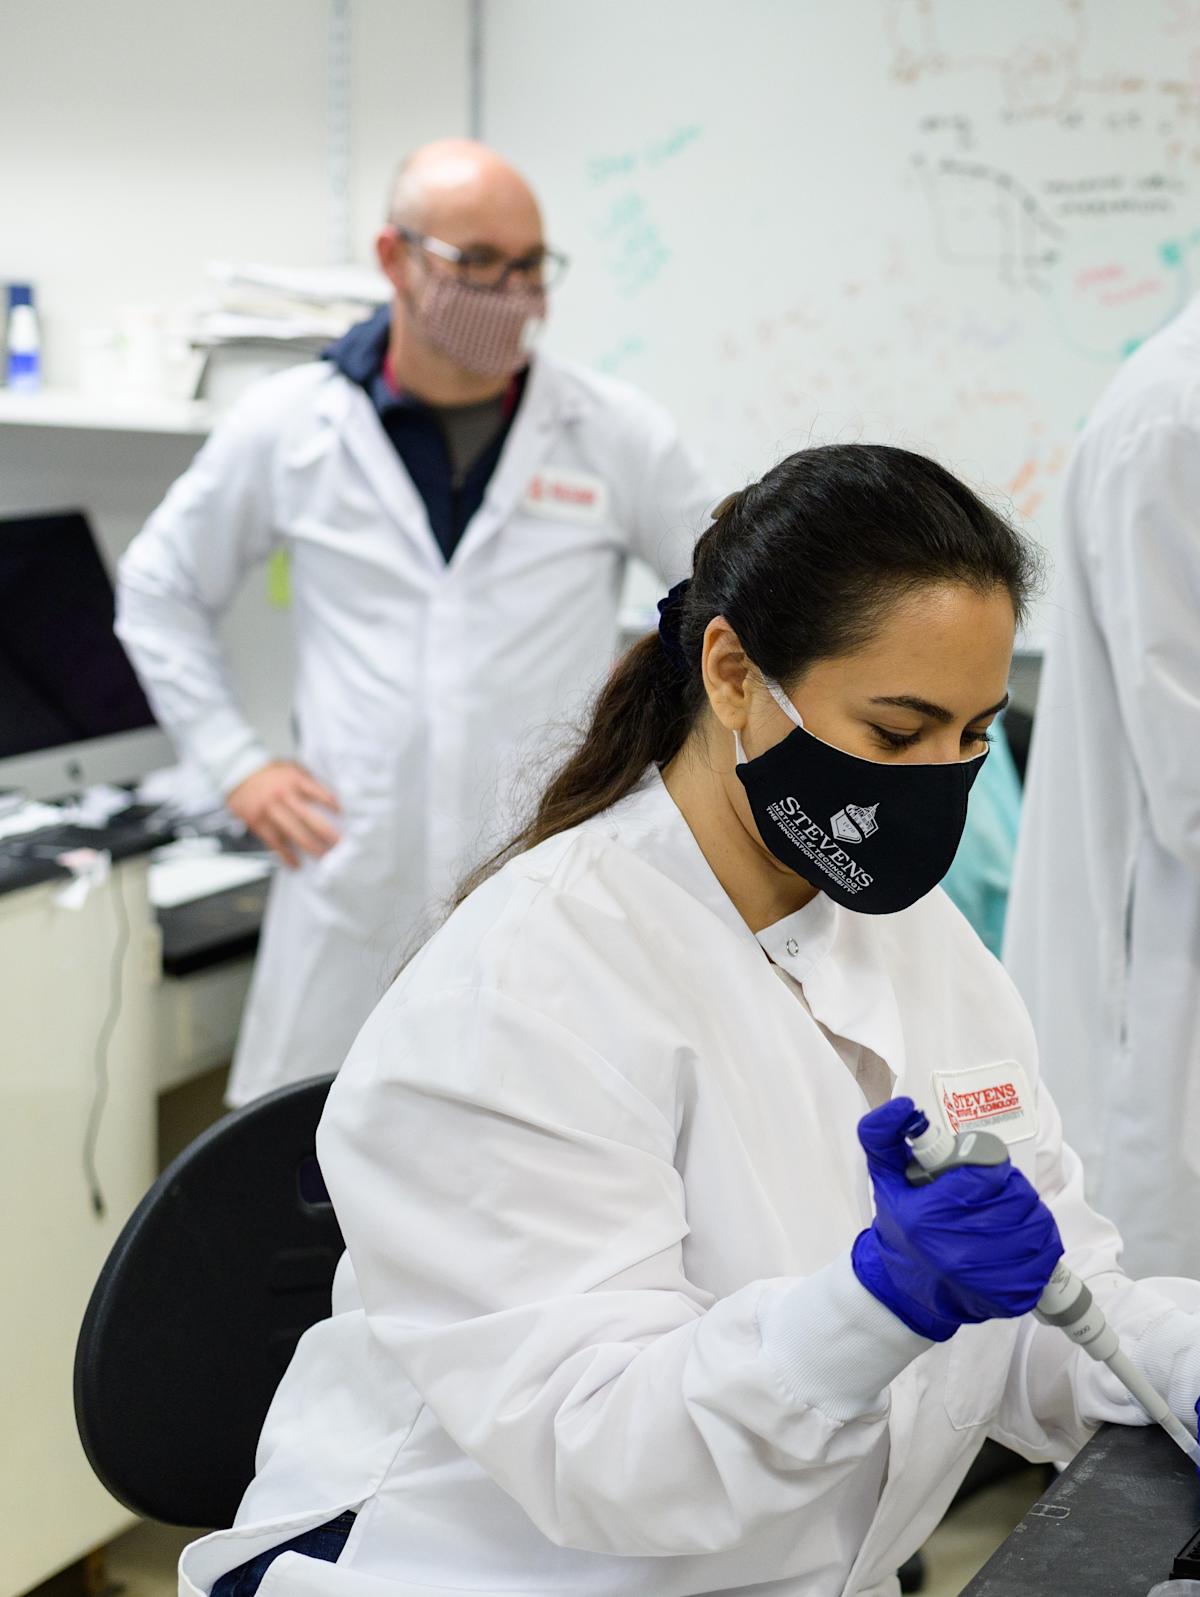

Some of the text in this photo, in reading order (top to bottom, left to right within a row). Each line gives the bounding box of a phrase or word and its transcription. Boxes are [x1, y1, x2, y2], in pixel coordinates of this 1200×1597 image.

[766, 806, 779, 822] THE
[777, 821, 815, 860] INNOVATION
[771, 802, 808, 841] INSTITUTE
[814, 848, 863, 891] TECHNOLOGY
[779, 796, 874, 887] STEVENS
[952, 1083, 1016, 1109] STEVENS
[980, 1097, 1019, 1113] TECHNOLOGY
